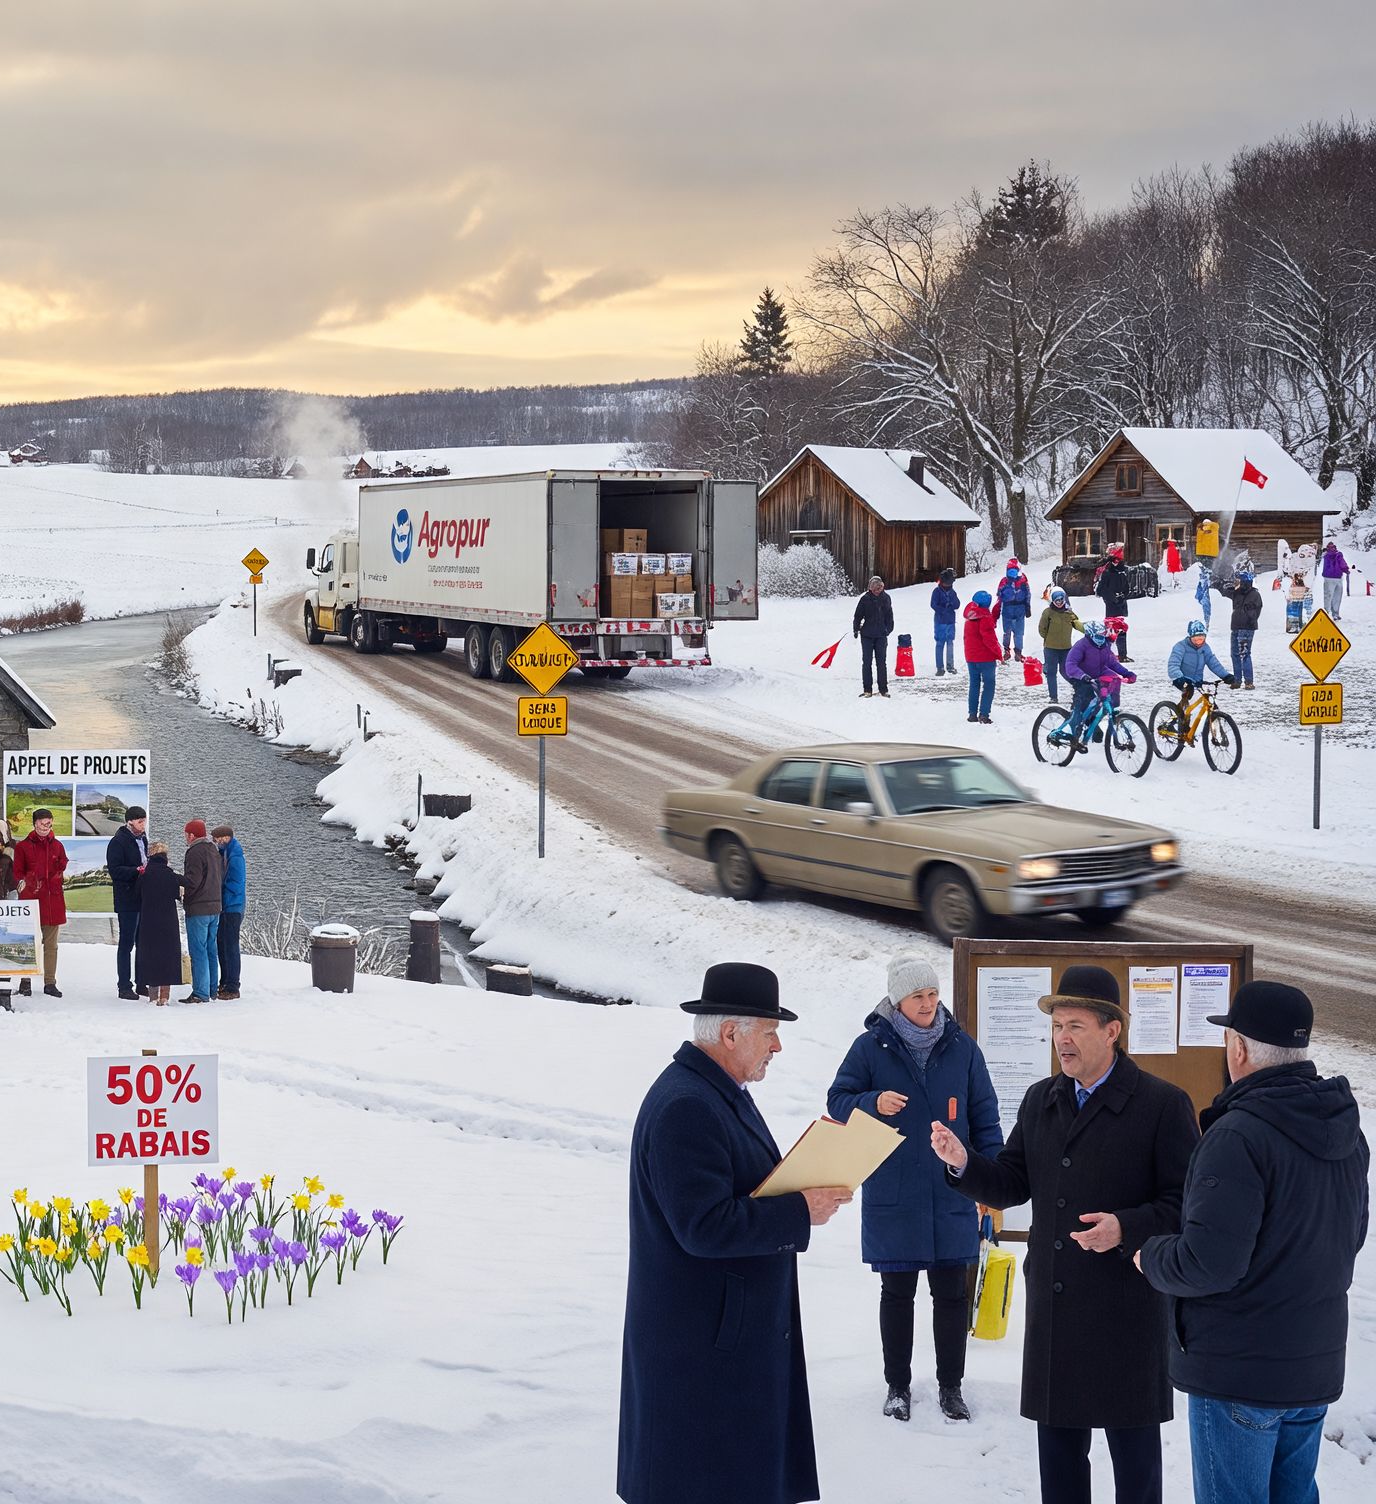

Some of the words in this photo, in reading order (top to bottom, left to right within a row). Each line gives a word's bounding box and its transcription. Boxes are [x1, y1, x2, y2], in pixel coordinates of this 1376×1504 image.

[417, 510, 491, 559] Agropur
[7, 755, 55, 775] APPEL
[60, 755, 79, 775] DE
[84, 755, 147, 775] PROJETS
[106, 1063, 202, 1105] 50%
[137, 1108, 167, 1128] DE
[95, 1129, 210, 1159] RABAIS
